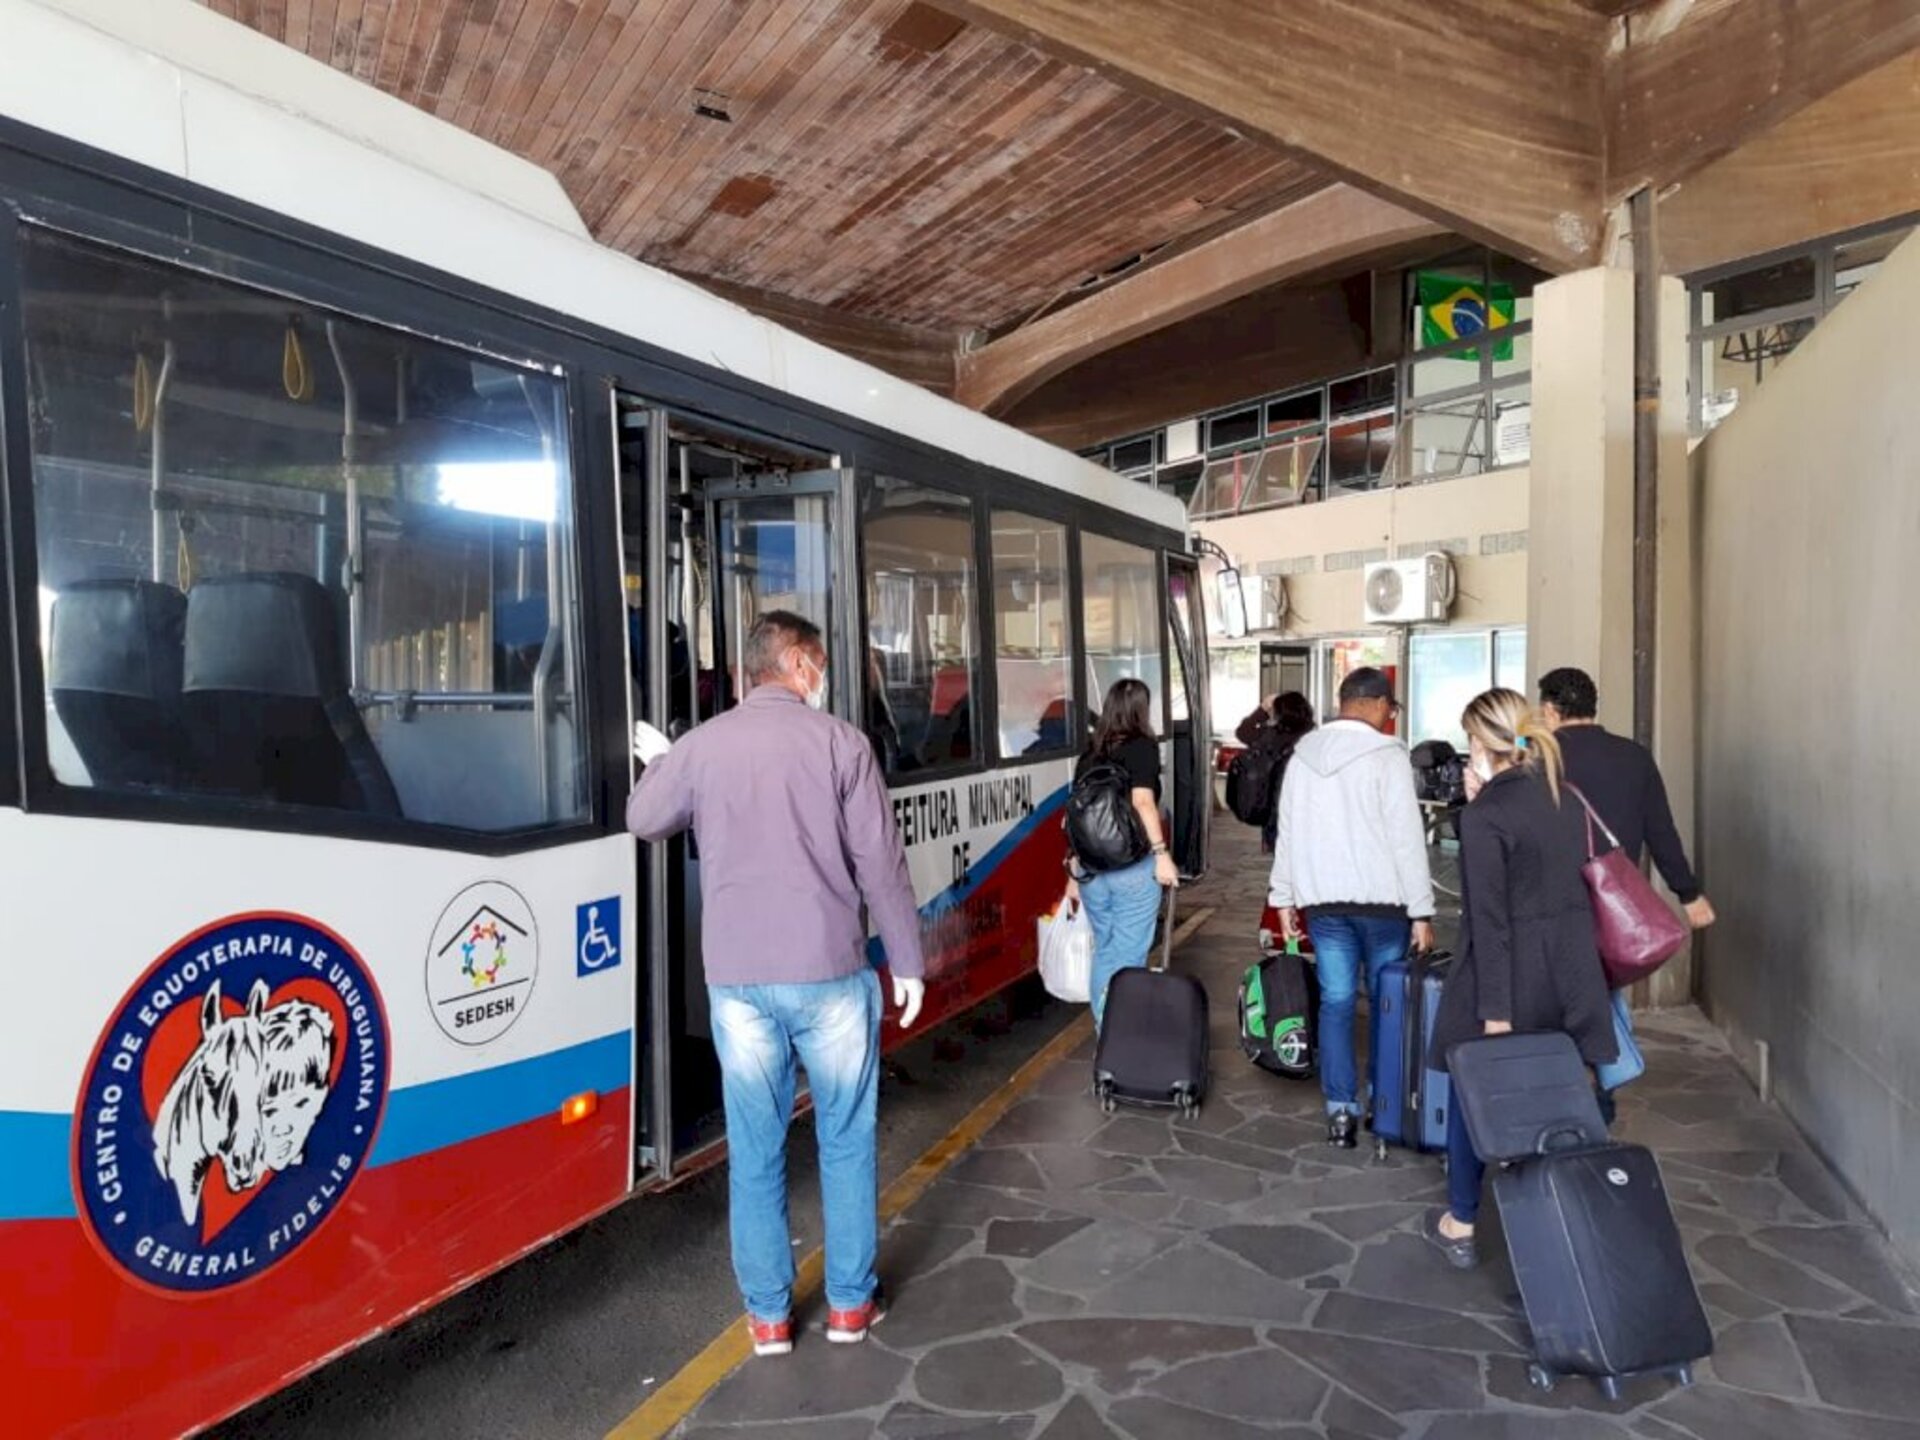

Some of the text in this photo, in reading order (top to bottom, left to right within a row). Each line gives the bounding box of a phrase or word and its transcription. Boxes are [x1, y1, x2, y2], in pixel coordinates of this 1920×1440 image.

[893, 774, 1034, 847] FEITURA MUNICIPAL
[952, 841, 970, 889] DE
[454, 996, 516, 1028] SEDESH
[95, 934, 375, 1203] CENTRO DE EQUOTERAPIA DE URUGUAIANA
[135, 1153, 352, 1276] GENERAL FIDELIS
